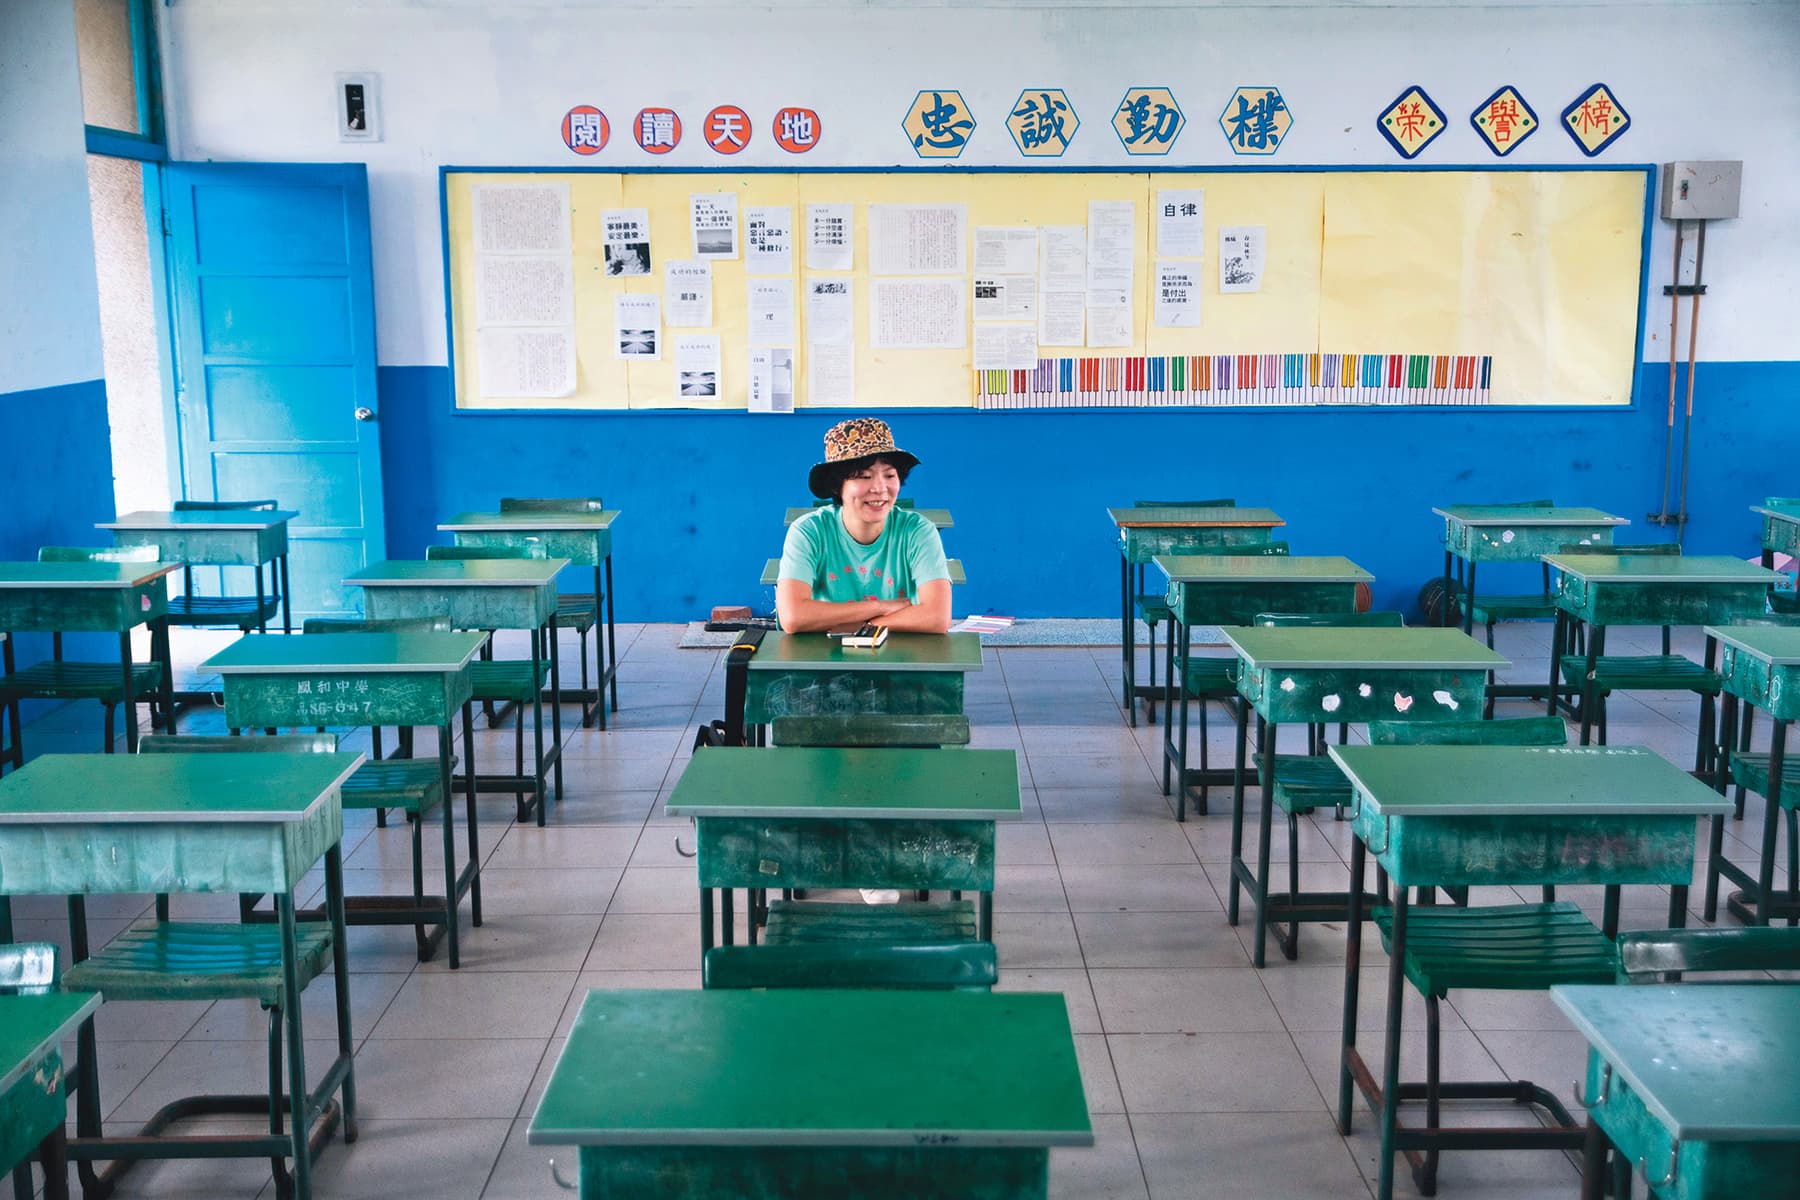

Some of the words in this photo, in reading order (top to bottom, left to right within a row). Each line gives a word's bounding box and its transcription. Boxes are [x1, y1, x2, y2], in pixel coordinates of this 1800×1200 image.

[569, 111, 815, 148] 閱讀天地
[915, 90, 1284, 149] 忠誠勤樸
[1396, 96, 1613, 142] 榮譽榜
[1164, 203, 1198, 217] 自律
[1162, 289, 1187, 298] 是付出
